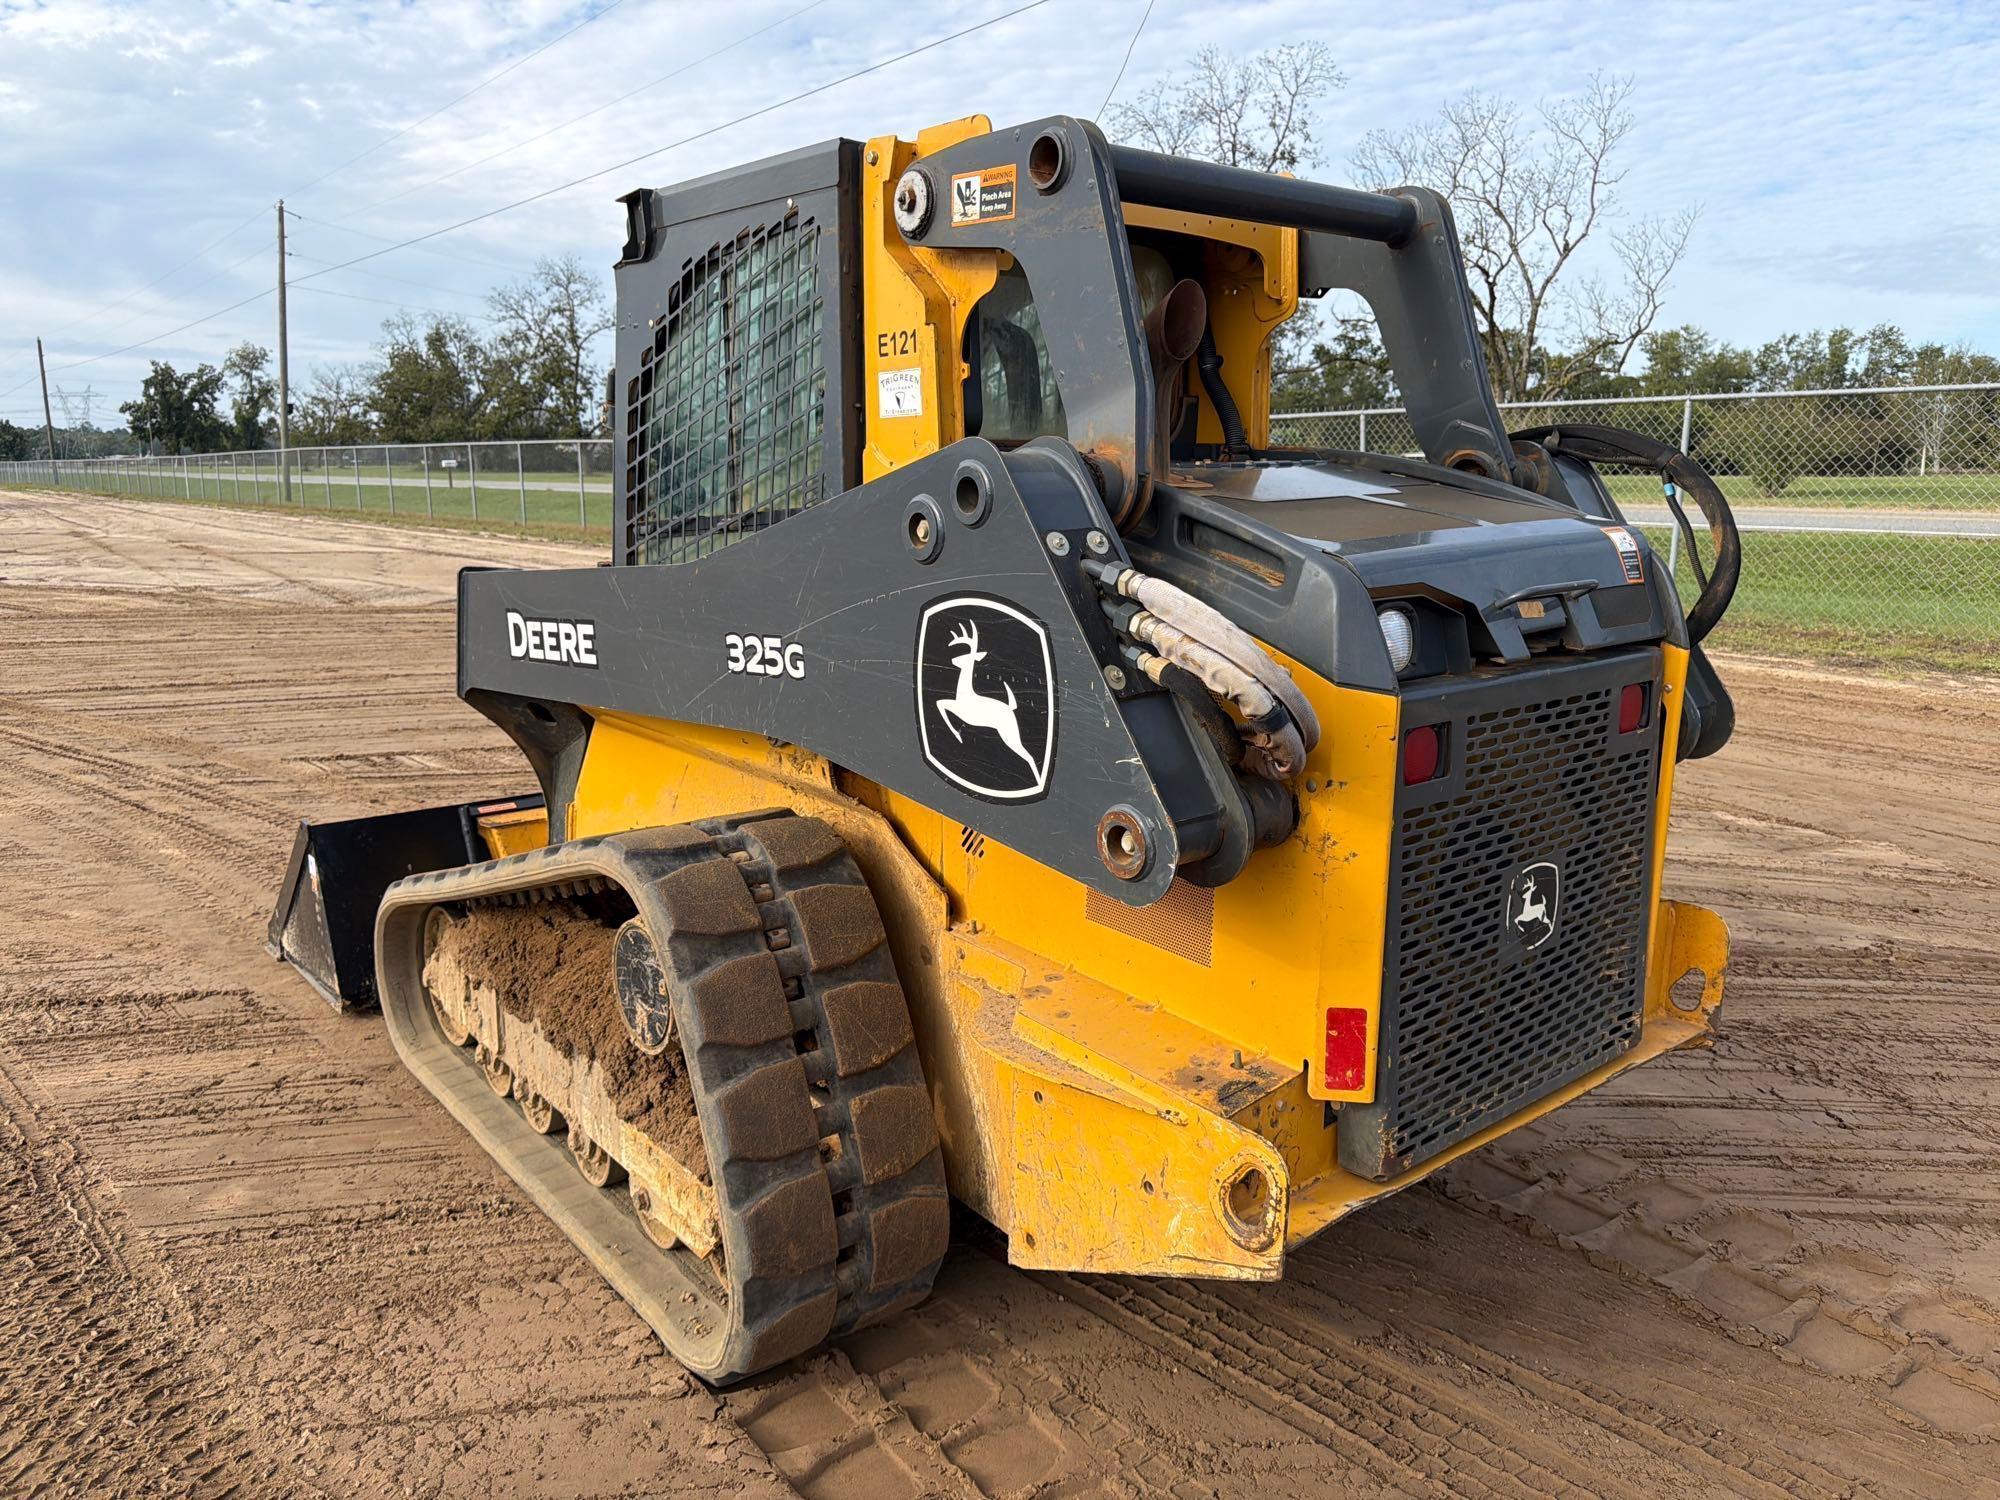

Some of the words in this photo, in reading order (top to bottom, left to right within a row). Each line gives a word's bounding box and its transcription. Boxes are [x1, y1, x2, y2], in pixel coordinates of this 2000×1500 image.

[988, 171, 1012, 180] WARNING
[982, 193, 997, 201] Pinch
[998, 191, 1011, 199] Area
[878, 329, 916, 357] E121
[506, 611, 598, 666] DEERE
[725, 634, 805, 679] 325G
